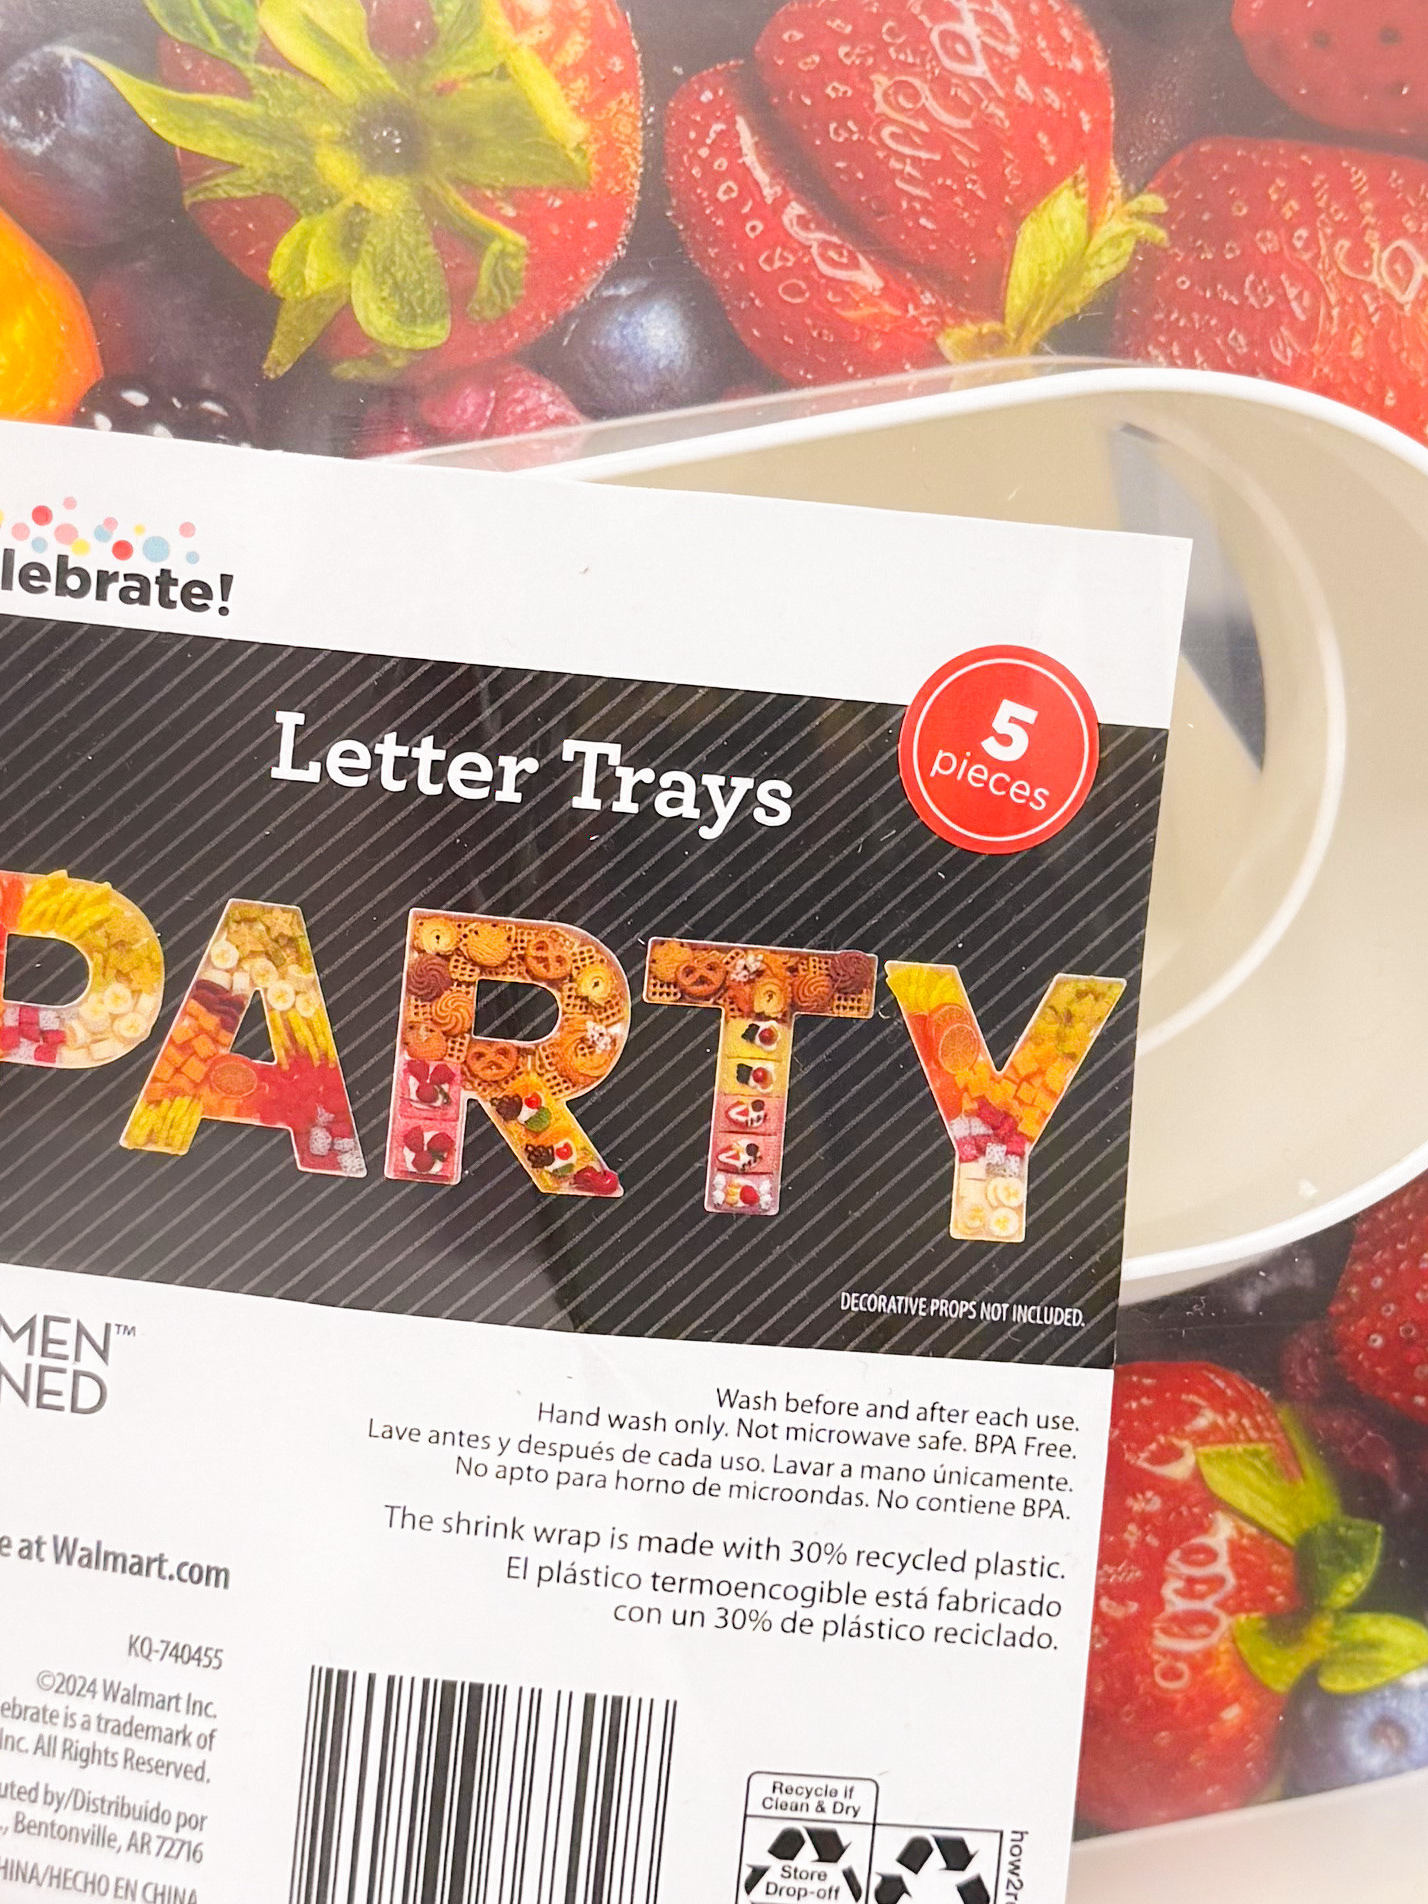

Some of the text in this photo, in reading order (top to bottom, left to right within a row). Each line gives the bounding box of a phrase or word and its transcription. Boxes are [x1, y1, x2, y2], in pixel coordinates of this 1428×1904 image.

[986, 700, 1035, 760] 5
[272, 711, 794, 841] Letter Trays
[930, 744, 1052, 817] pieces
[840, 1291, 1086, 1327] DECORATIVE PROPS NOT INCLUDED.
[537, 1401, 1077, 1460] Hand wash only. Not microwave safe. BPA Free.
[716, 1387, 1080, 1432] Wash before and after each use.
[368, 1417, 1074, 1493] Lave antes y después de cada uso. Lavar a mano únicamente.
[455, 1455, 1071, 1520] No apto para horno de microondas. No contiene BPA.
[17, 1535, 47, 1563] at
[52, 1534, 230, 1590] Walmart.com
[384, 1504, 1066, 1581] The shrink wrap is made with 30% recycled plastic.
[506, 1555, 1062, 1618] El plástico termoencogible está fabricado
[127, 1634, 224, 1671] KQ-740455
[613, 1604, 1058, 1651] con un 30% de plástico reciclado.
[36, 1670, 217, 1719] ©2024 Walmart Inc.
[63, 1705, 77, 1729] is
[80, 1714, 91, 1731] a
[96, 1713, 193, 1748] trademark
[196, 1728, 218, 1752] of
[32, 1733, 58, 1758] All
[61, 1737, 119, 1770] Rights
[122, 1747, 210, 1784] Reserved.
[42, 1783, 172, 1826] by/Distribuido
[174, 1811, 208, 1834] por
[761, 1797, 862, 1819] Clean & Dry
[772, 1781, 855, 1800] Recycle if
[13, 1811, 122, 1854] Bentonville,
[126, 1830, 152, 1855] AR
[154, 1835, 204, 1864] 72716
[113, 1876, 138, 1902] EN
[765, 1881, 840, 1902] Drop-off
[780, 1864, 828, 1882] Store
